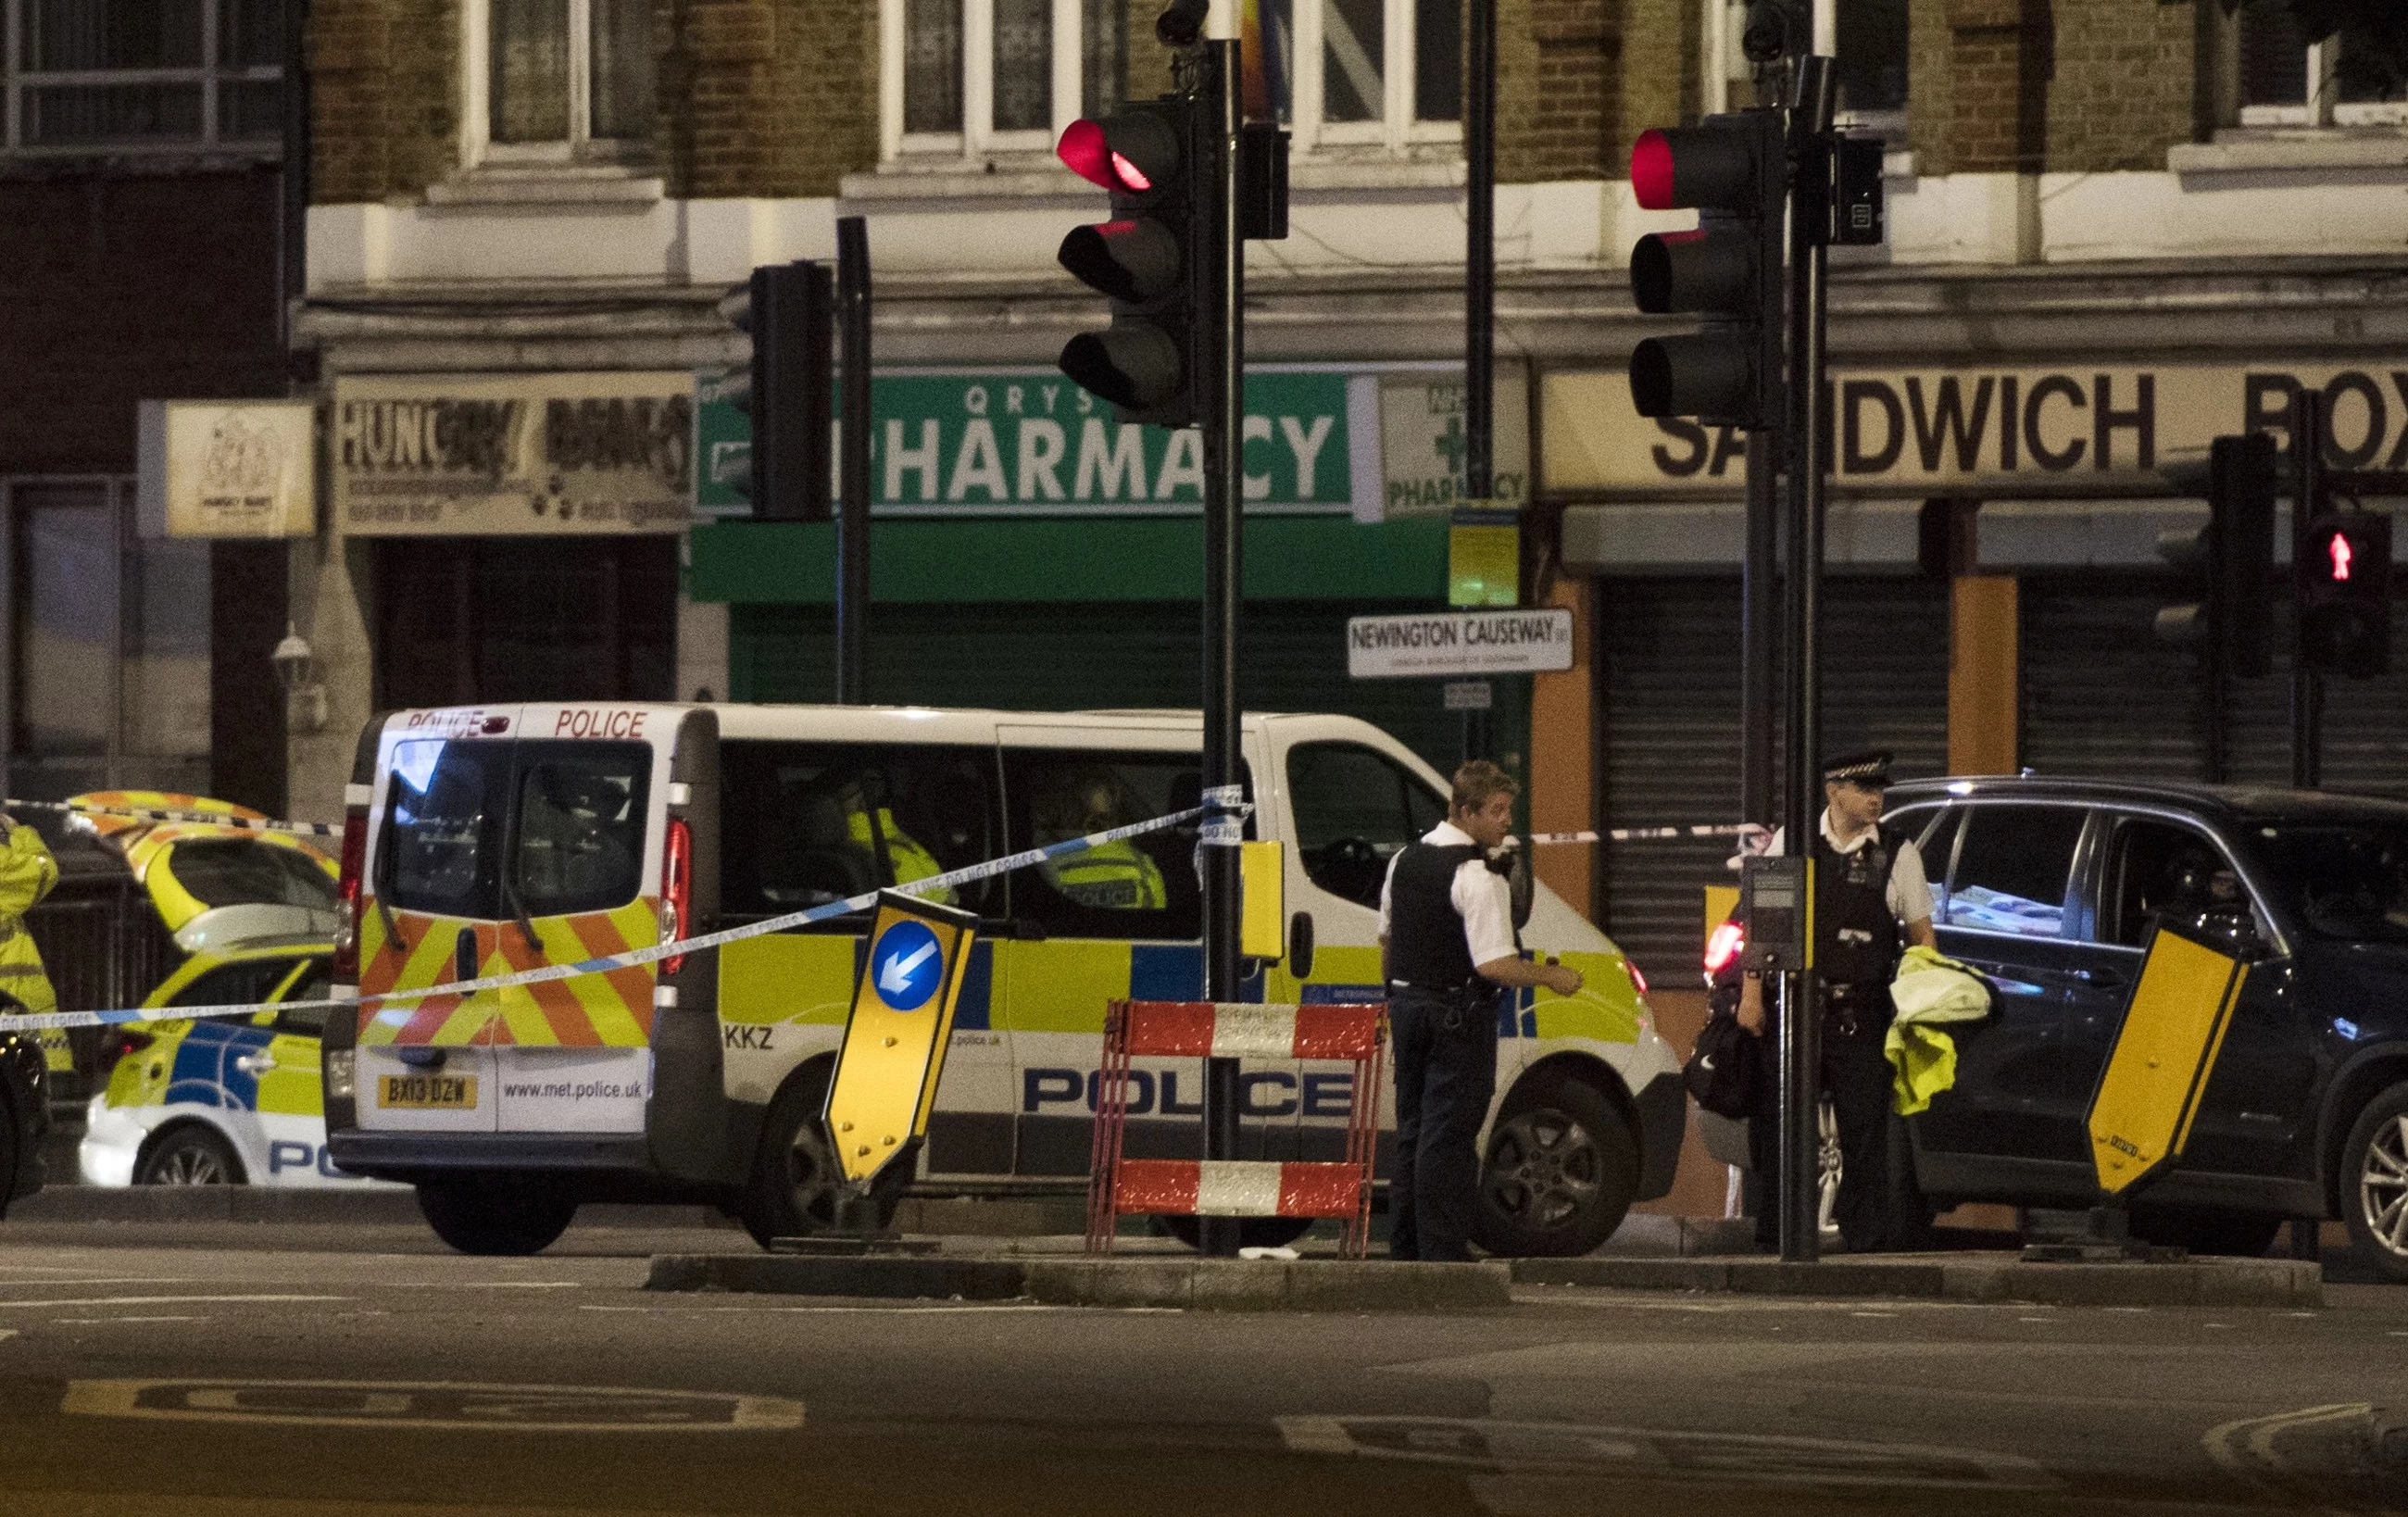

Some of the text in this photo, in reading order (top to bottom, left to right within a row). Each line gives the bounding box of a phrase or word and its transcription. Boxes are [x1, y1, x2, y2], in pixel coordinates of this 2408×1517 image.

[966, 385, 1094, 413] QRYS
[1651, 372, 2408, 477] SDWICH BO
[1389, 472, 1524, 506] PHARCY
[1352, 621, 1458, 649] NEWINGTON
[1465, 617, 1554, 646] CAUSEWAY
[408, 709, 484, 738] POLICE
[555, 709, 648, 738] POLICE
[724, 1024, 773, 1050] KKZ
[387, 1077, 428, 1102] BX13
[503, 1080, 642, 1102] www.met.police.uk
[1023, 1069, 1355, 1115] POLCE
[270, 1139, 339, 1178] PO
